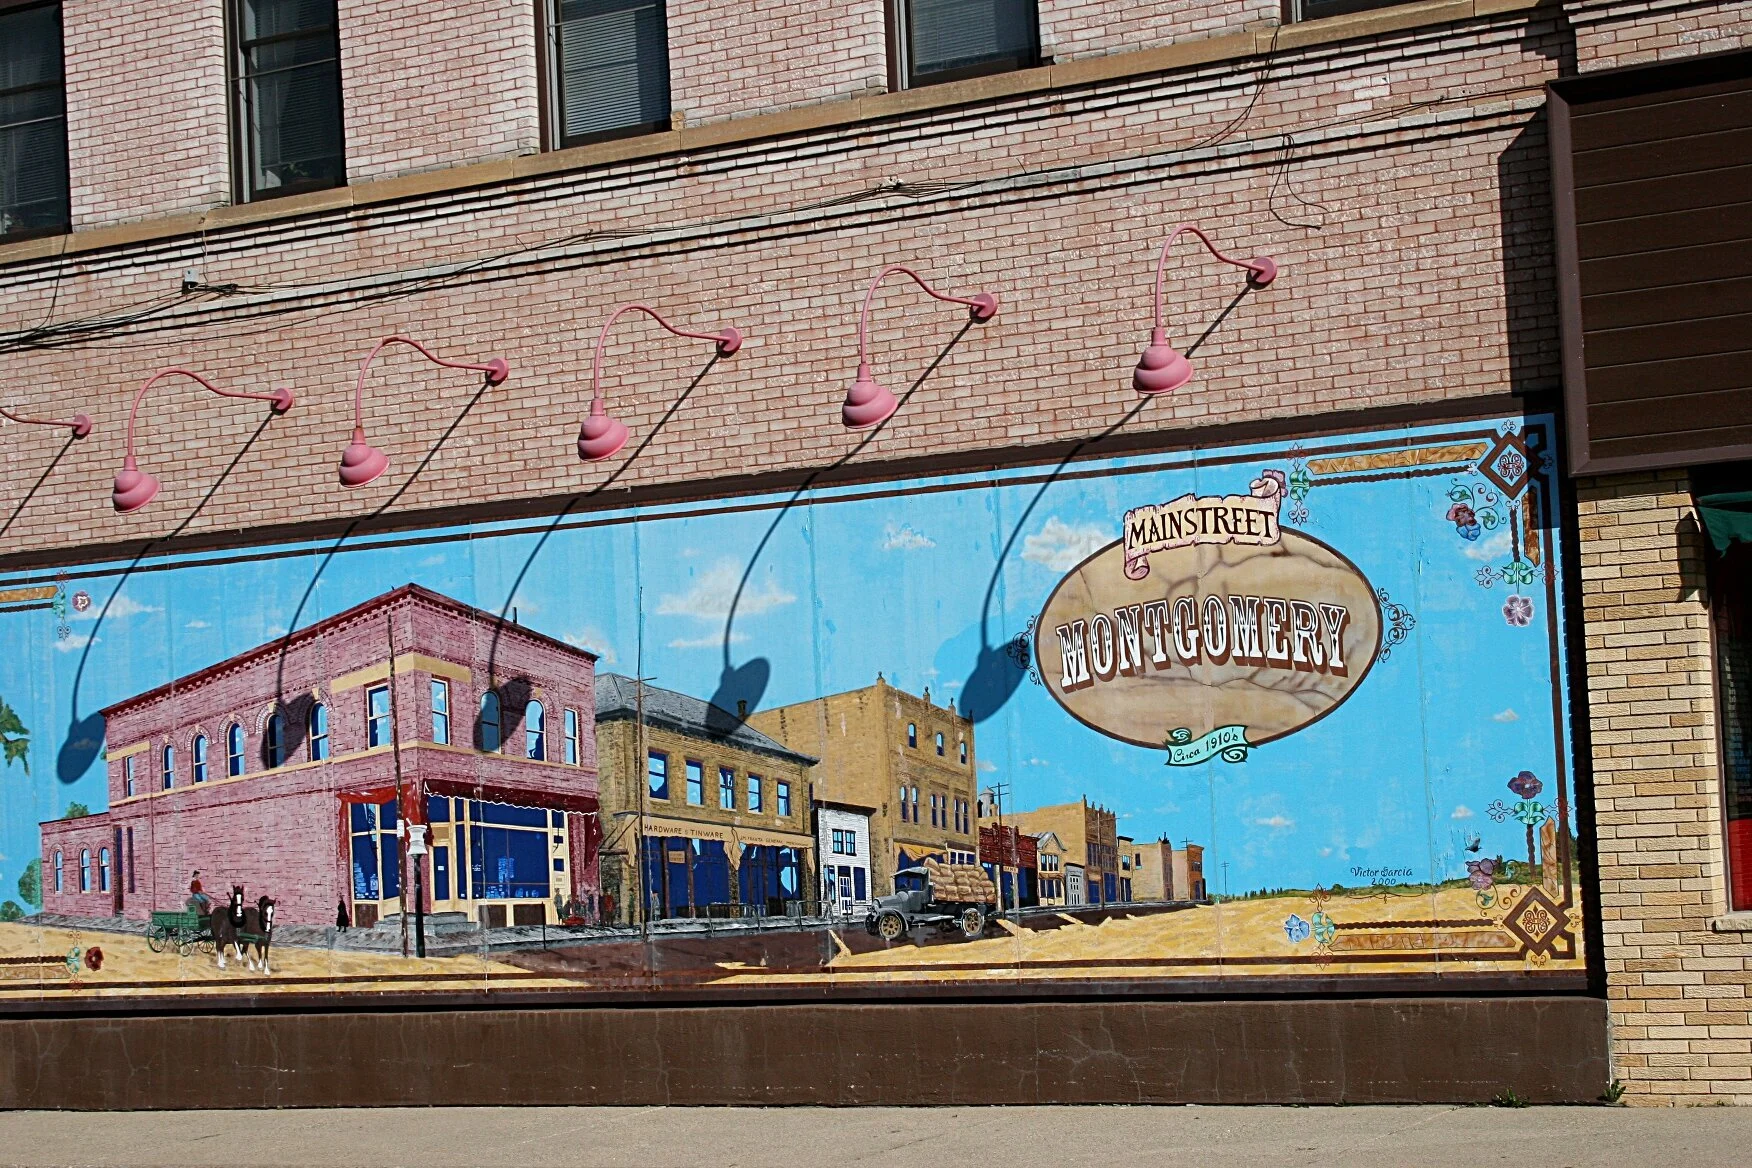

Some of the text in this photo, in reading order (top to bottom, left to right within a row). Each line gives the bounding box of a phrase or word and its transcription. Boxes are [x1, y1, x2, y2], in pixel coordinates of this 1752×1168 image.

[1128, 506, 1274, 549] MAINSTREET
[1056, 594, 1348, 690] MONTGOMERY
[1174, 727, 1238, 762] Circa 1910's
[644, 823, 682, 834] HARDWARE
[690, 829, 724, 839] TINWARE
[1350, 866, 1379, 877] Victor
[1371, 877, 1396, 886] 2000
